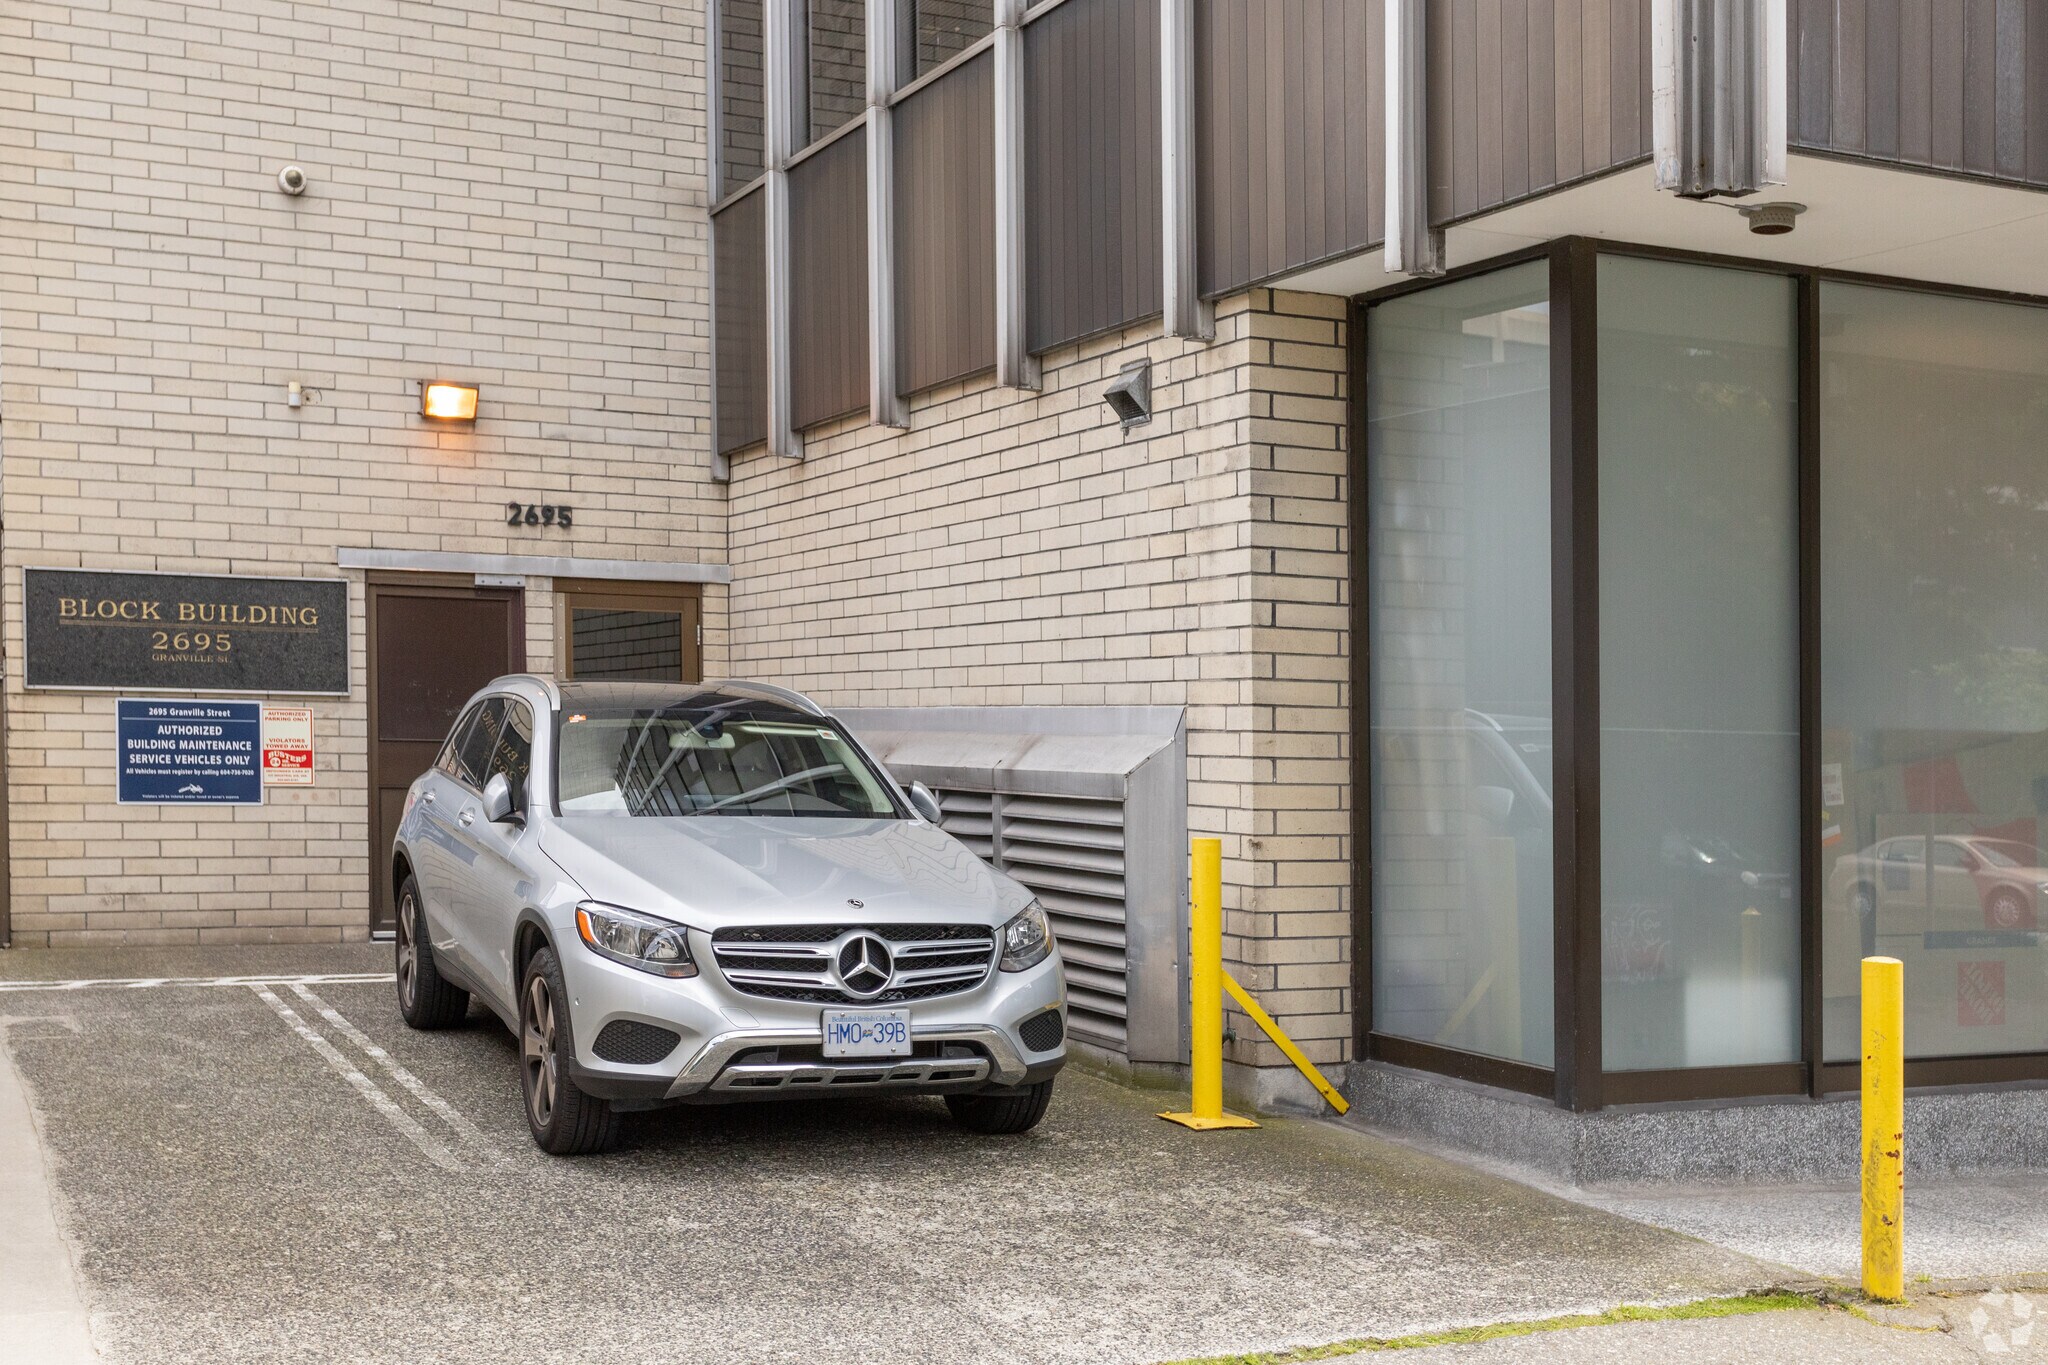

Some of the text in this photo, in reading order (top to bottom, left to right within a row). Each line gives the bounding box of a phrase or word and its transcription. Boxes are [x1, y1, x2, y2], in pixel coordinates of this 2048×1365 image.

[508, 502, 572, 528] 2695
[59, 598, 318, 625] BLOCK BUILDING
[152, 632, 232, 652] 2695
[152, 653, 214, 663] GRANVILLE
[149, 707, 231, 717] 2695 Granville Street
[157, 725, 223, 735] AUTHORIZED
[127, 738, 252, 751] BUILDING MAINTENANCE
[129, 753, 251, 766] SERVICE VEHICLES ONLY
[268, 751, 307, 762] BUSTERS
[126, 767, 134, 775] All
[134, 767, 157, 775] Vehicles
[193, 768, 201, 776] by
[201, 768, 219, 777] calling
[873, 1022, 906, 1043] 39B
